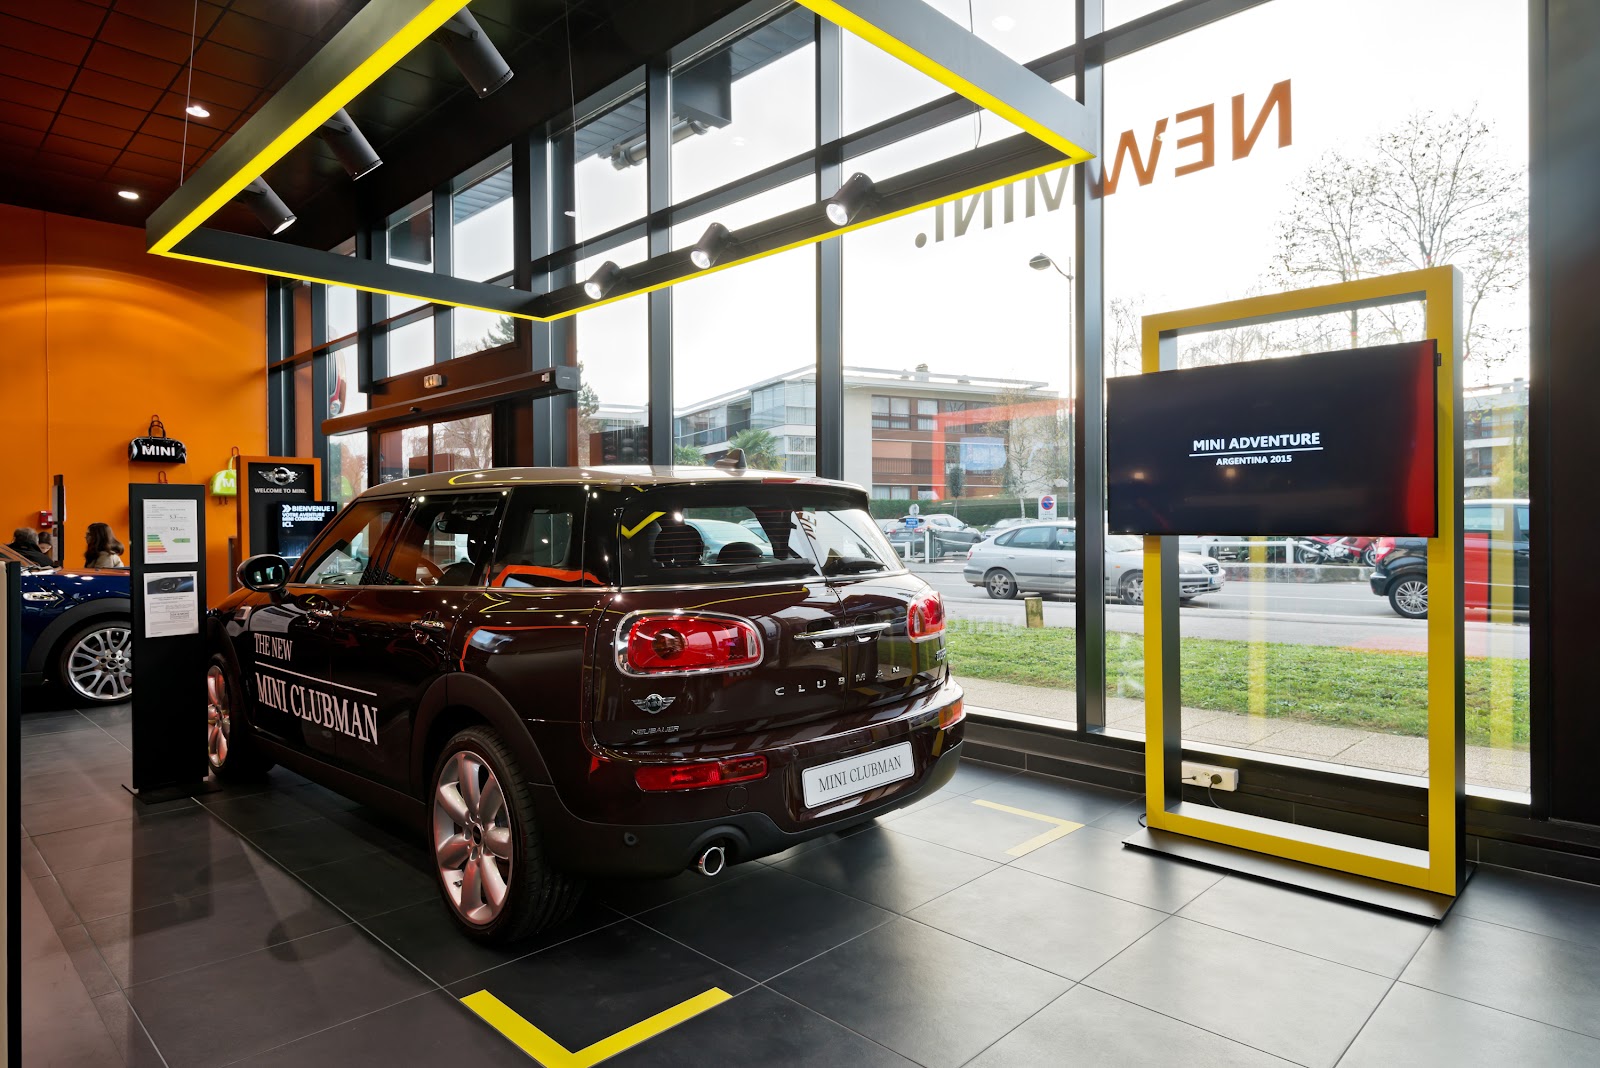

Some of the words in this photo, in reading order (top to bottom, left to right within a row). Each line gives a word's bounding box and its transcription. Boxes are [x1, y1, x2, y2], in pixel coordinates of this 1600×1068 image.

[142, 445, 176, 457] MINI
[1193, 438, 1225, 451] MINI
[1229, 432, 1320, 450] ADVENTURE
[1216, 456, 1268, 466] ARGENTINA
[1270, 455, 1292, 463] 2015
[254, 632, 271, 656] THE
[271, 636, 293, 661] NEW
[774, 666, 900, 696] CLUBMAN
[255, 672, 288, 713] MINI
[290, 684, 378, 745] CLUBMAN
[631, 725, 680, 736] NEUBAUER
[818, 771, 847, 793] MINI
[849, 755, 903, 783] CLUBMAN
